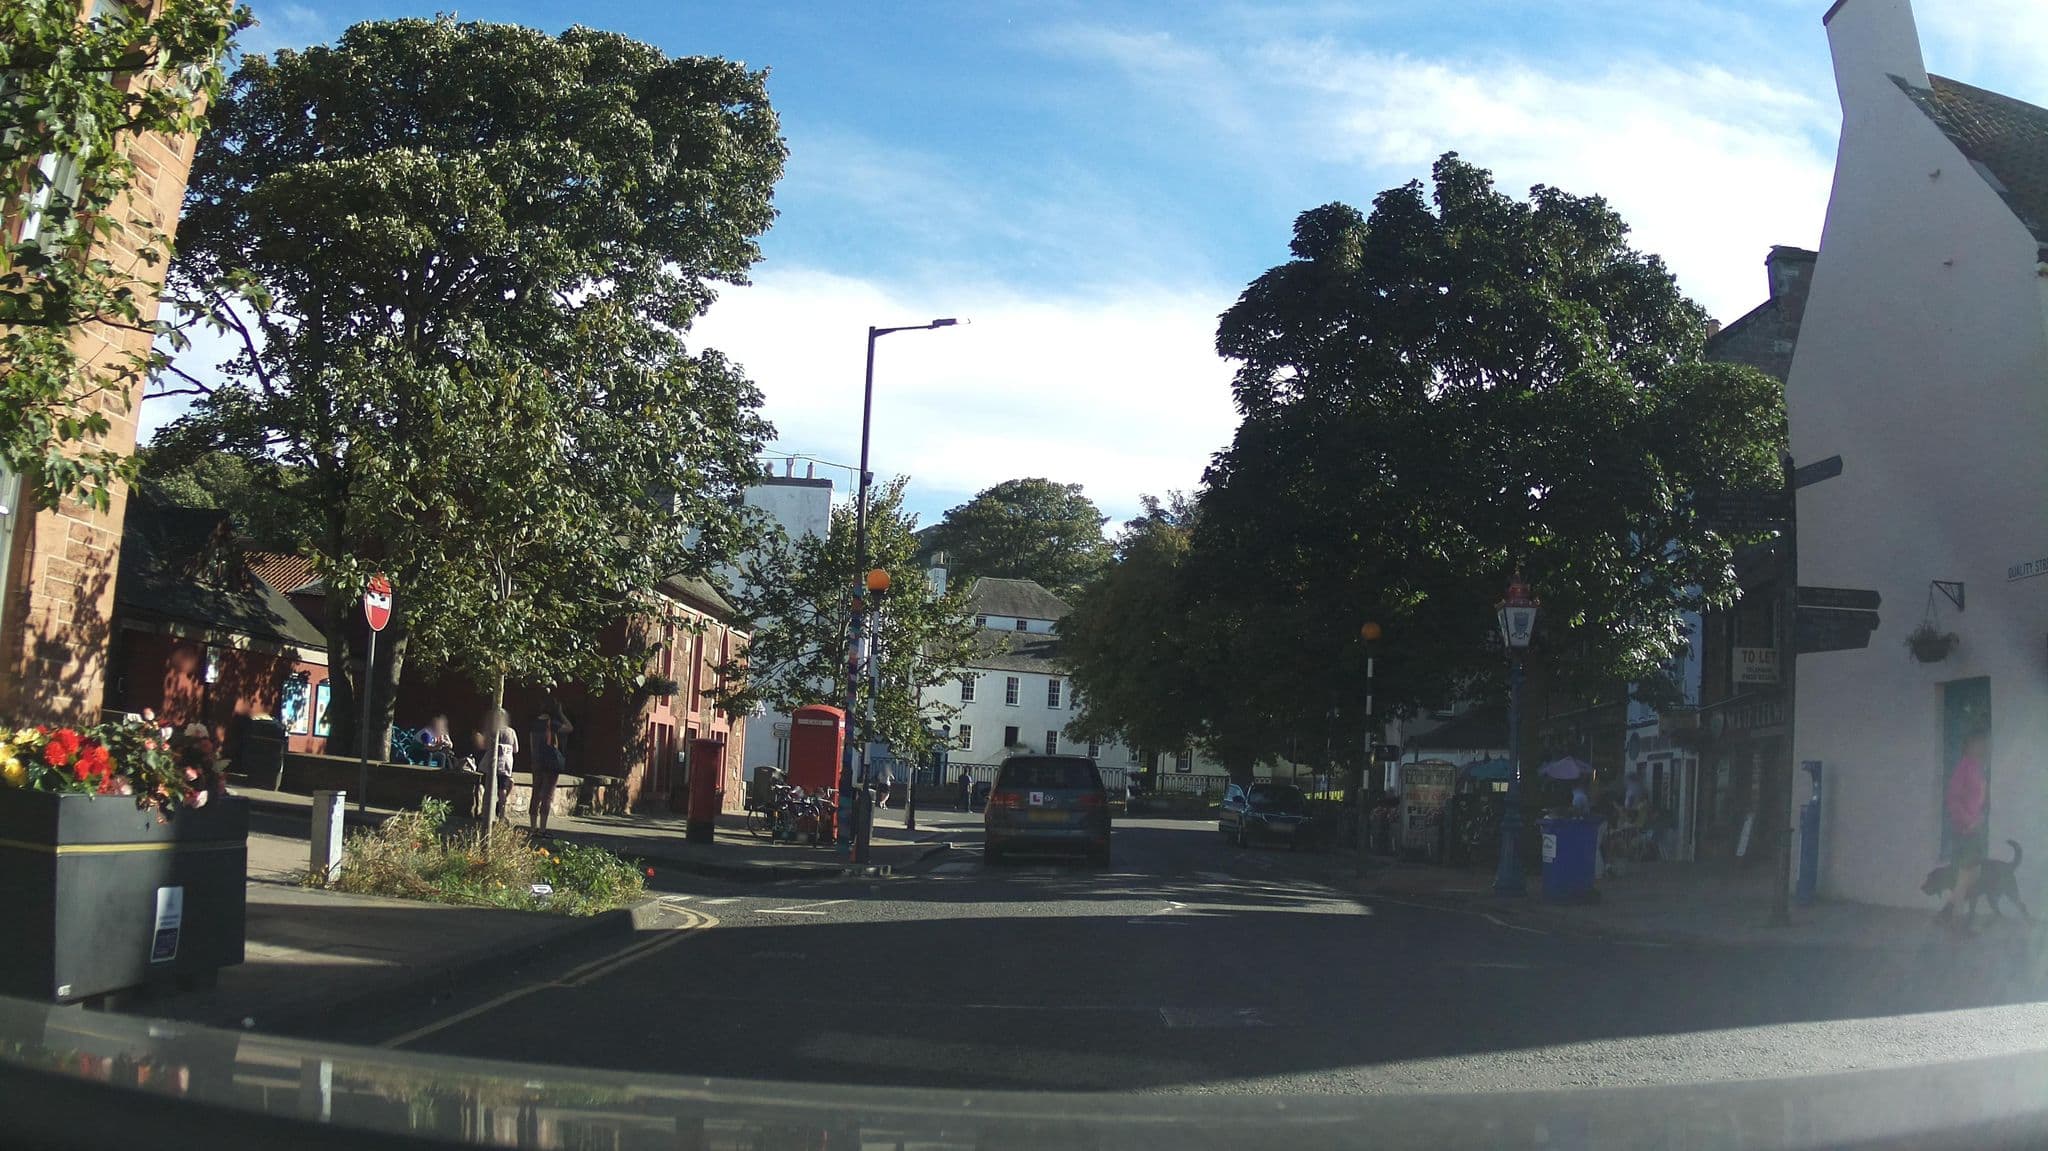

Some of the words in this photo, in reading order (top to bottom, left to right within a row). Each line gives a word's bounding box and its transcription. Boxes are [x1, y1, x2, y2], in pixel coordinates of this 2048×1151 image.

[2008, 562, 2033, 579] QUALITY
[2035, 557, 2048, 573] STR
[1742, 650, 1756, 663] TO
[1759, 650, 1777, 664] LET
